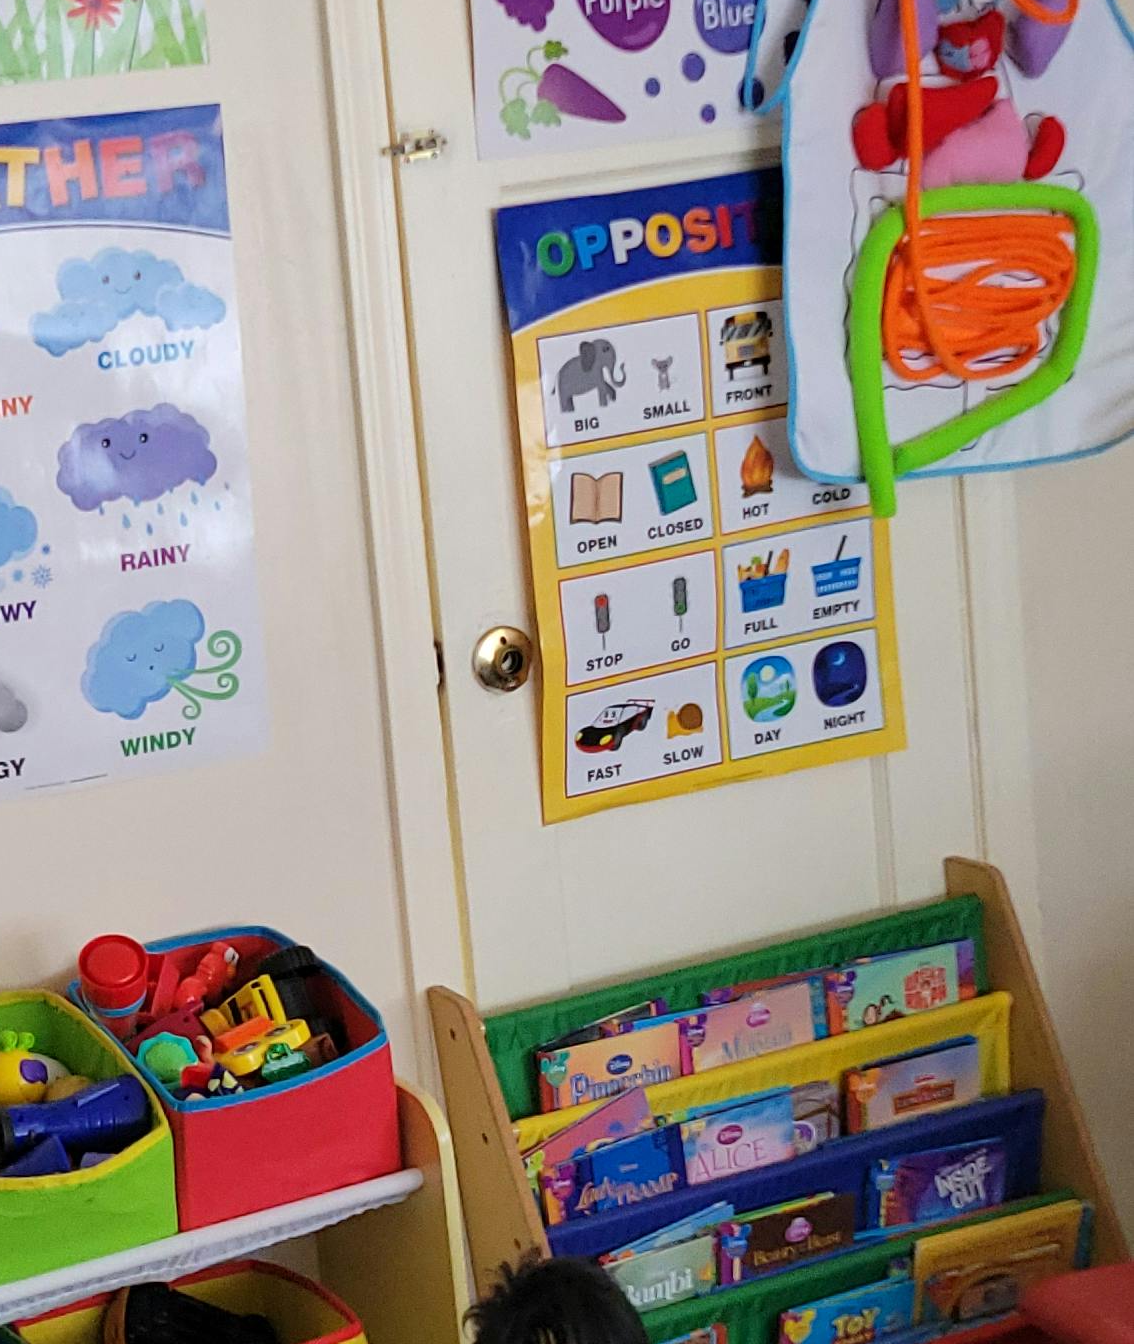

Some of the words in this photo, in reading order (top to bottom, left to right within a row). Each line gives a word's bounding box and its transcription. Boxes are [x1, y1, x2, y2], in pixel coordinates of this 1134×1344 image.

[702, 0, 756, 31] Blue
[536, 200, 763, 277] OPPOSIT
[97, 340, 195, 371] CLOUDY
[725, 384, 772, 405] FRONT
[574, 416, 600, 432] BIG
[642, 400, 691, 421] SMALL
[742, 502, 770, 519] HOT
[811, 487, 851, 506] COLD
[577, 534, 618, 554] OPEN
[647, 517, 704, 540] CLOSED
[120, 543, 191, 572] RAINY
[743, 617, 779, 636] FULL
[812, 599, 861, 621] EMPTY
[585, 652, 624, 672] STOP
[670, 637, 691, 652] GO
[120, 727, 197, 757] WINDY
[753, 728, 782, 746] DAY
[823, 710, 866, 730] NIGHT
[586, 763, 623, 783] FAST
[662, 744, 704, 766] SLOW
